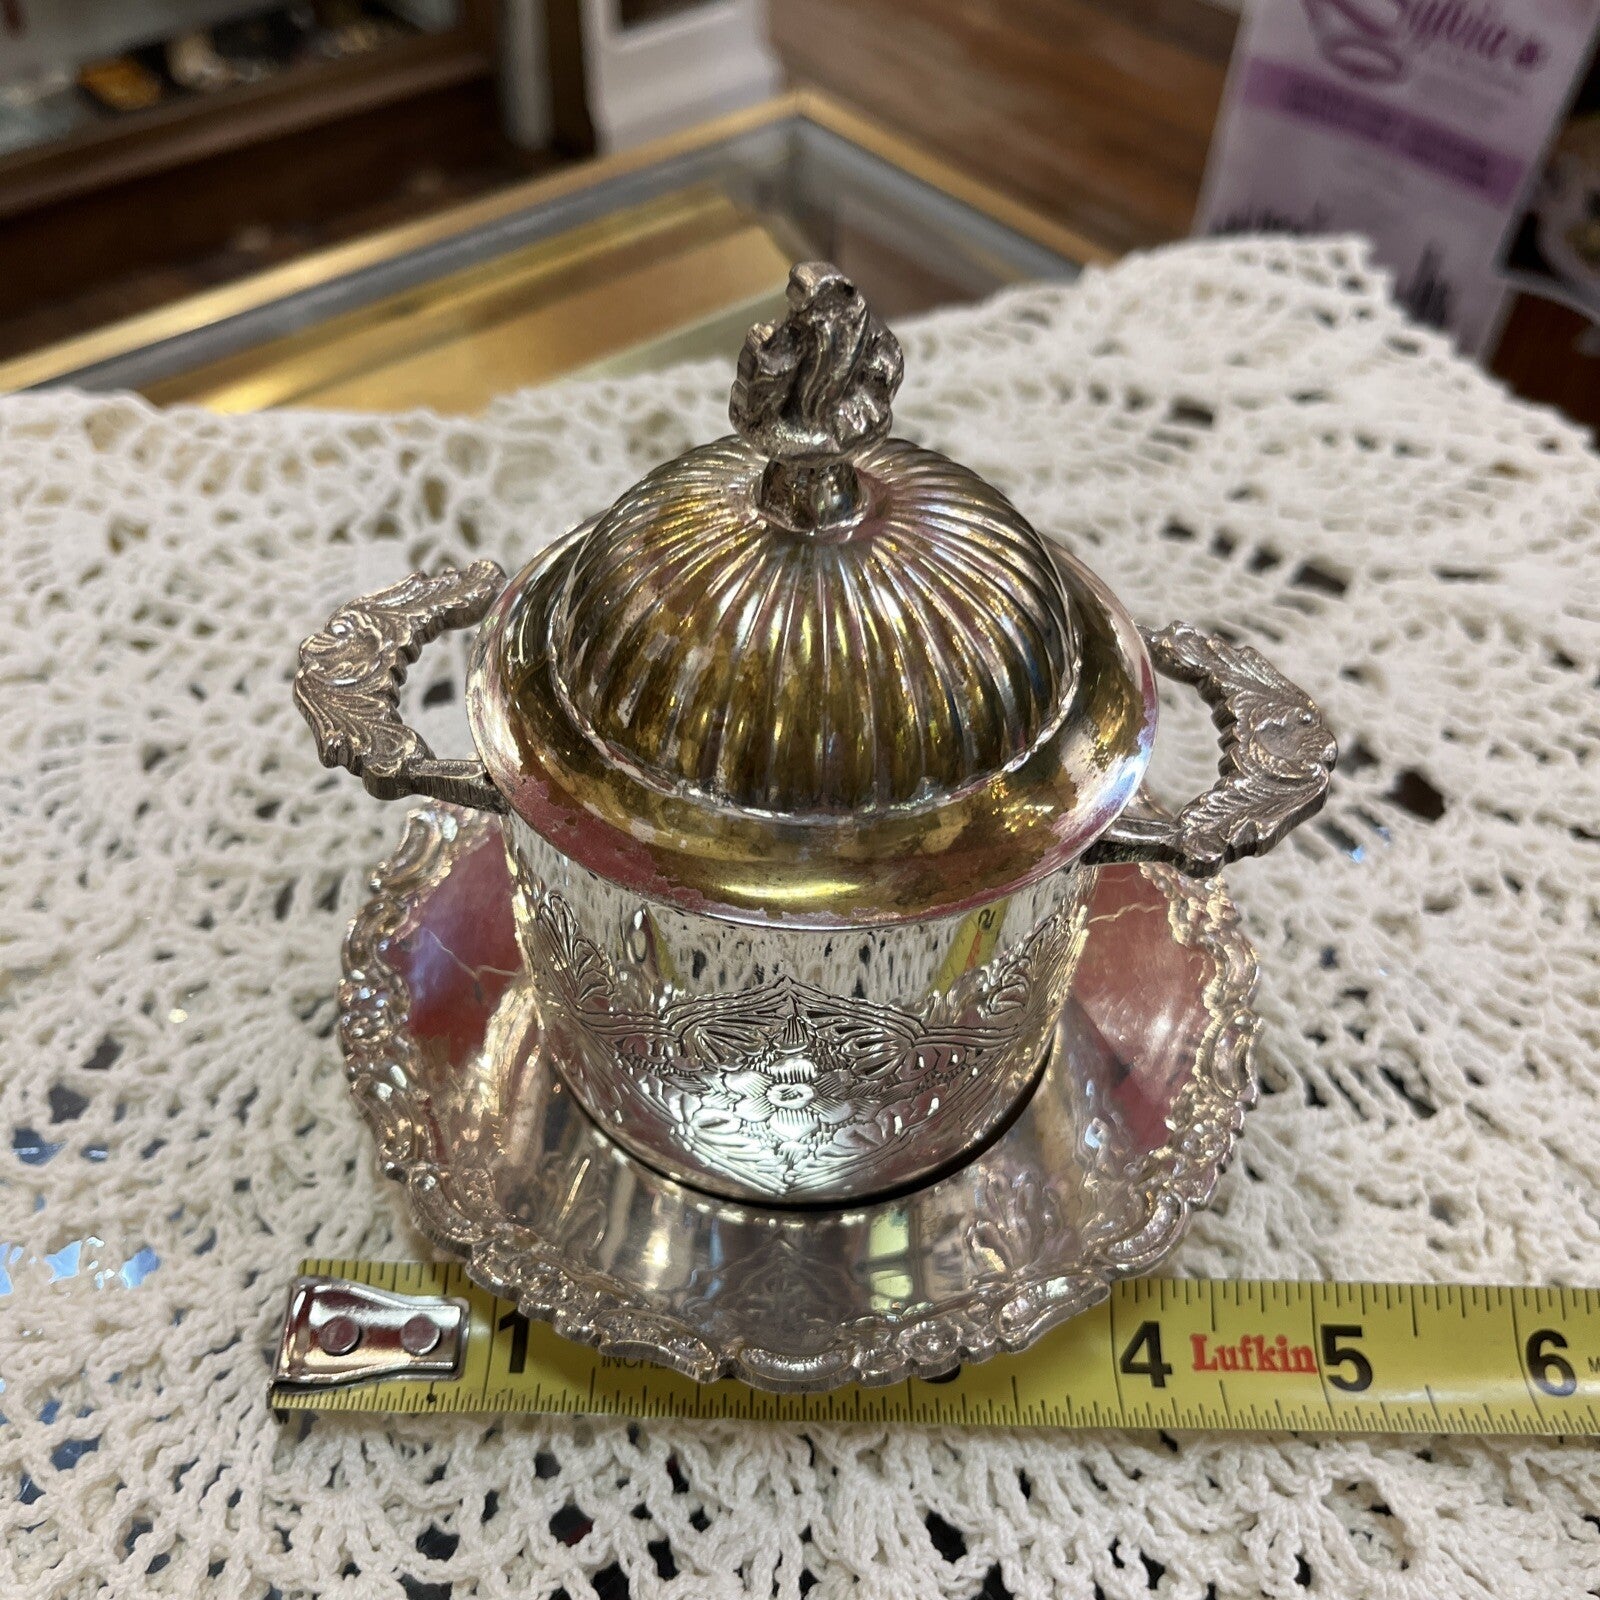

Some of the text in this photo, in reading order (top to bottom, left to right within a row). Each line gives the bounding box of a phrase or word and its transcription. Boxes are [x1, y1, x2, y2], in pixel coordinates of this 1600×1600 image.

[498, 1308, 530, 1374] 1
[1120, 1320, 1173, 1388] 4
[1190, 1333, 1318, 1375] Lufkin
[1320, 1324, 1373, 1392] 5
[1526, 1328, 1577, 1396] 6
